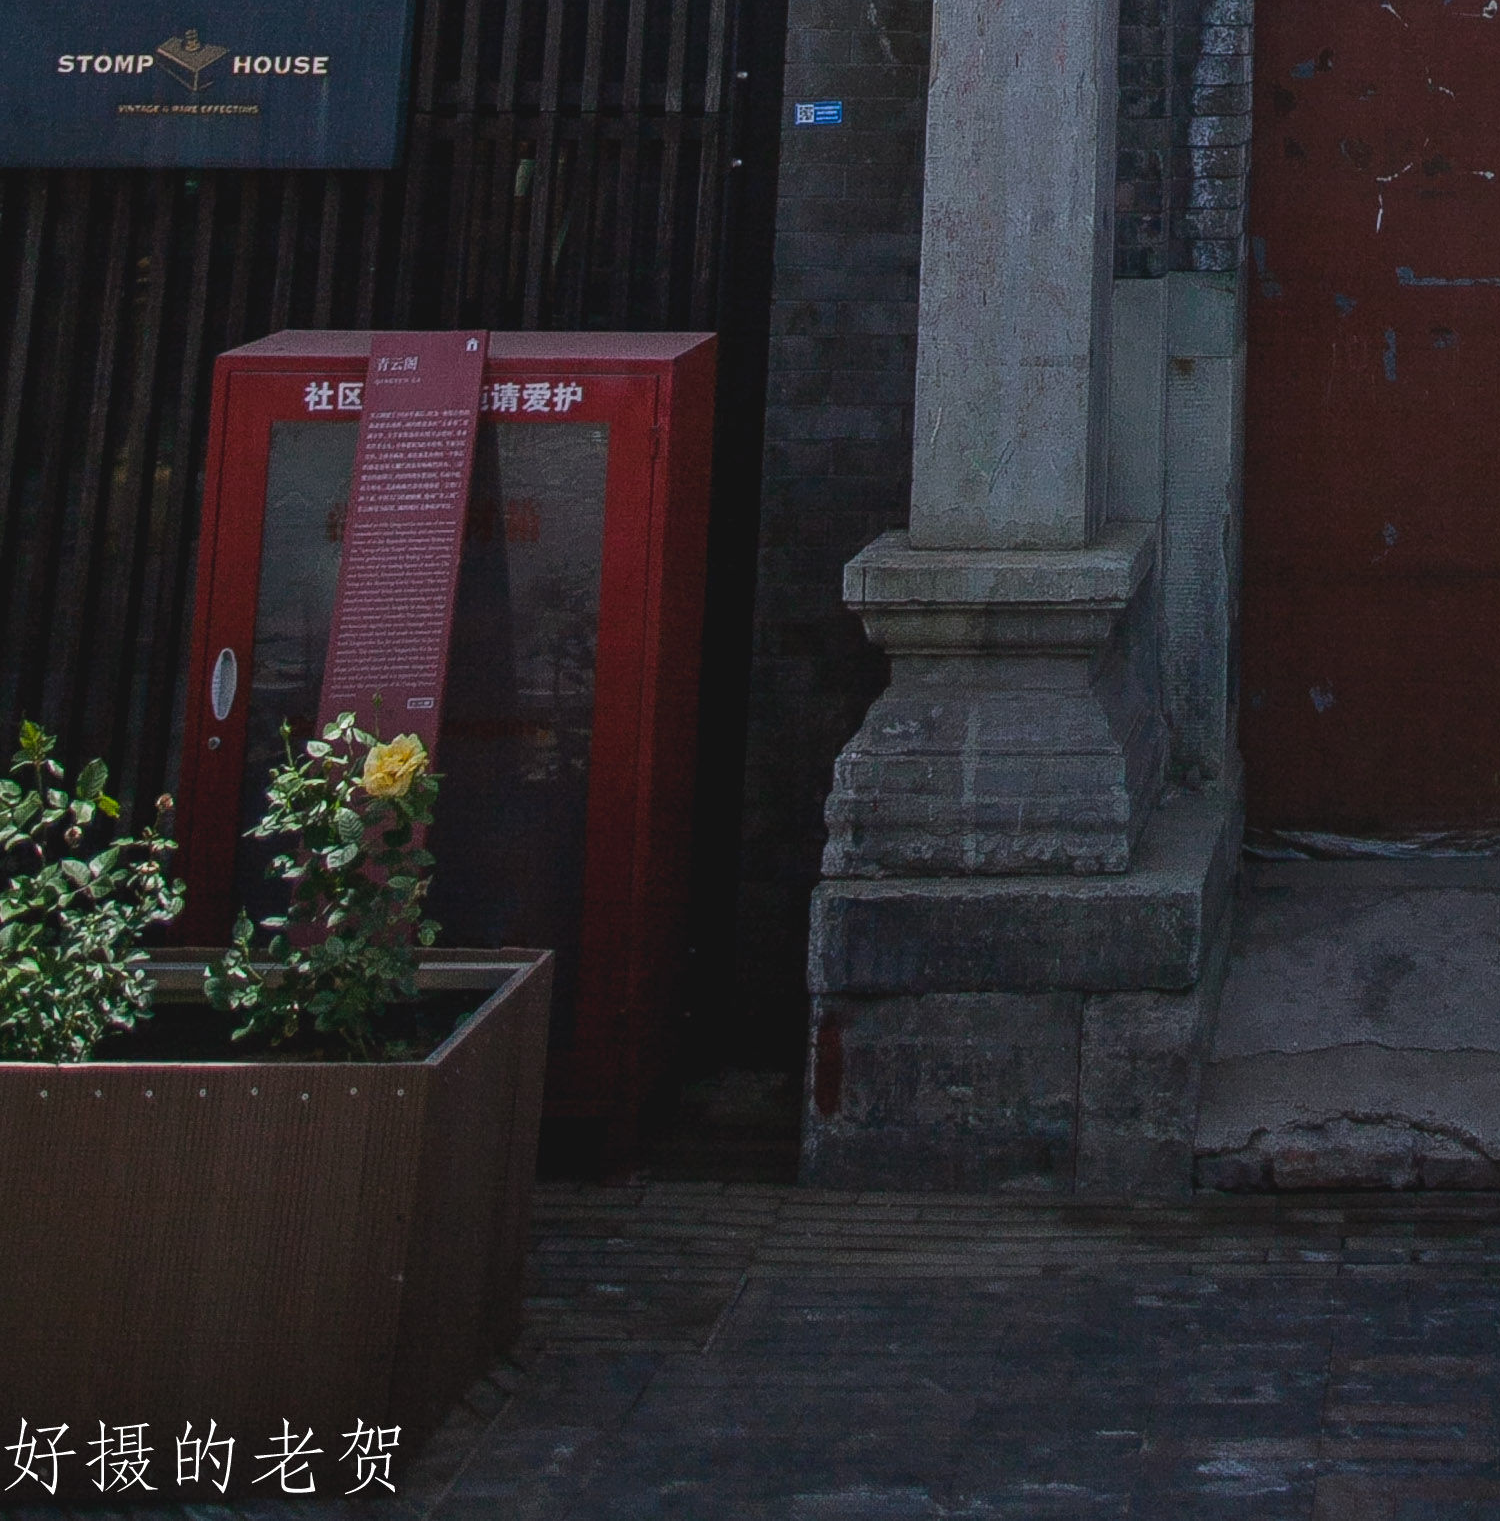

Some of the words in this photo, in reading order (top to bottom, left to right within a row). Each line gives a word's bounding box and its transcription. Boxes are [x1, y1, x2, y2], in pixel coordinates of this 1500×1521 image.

[57, 55, 154, 74] STOMP
[233, 55, 329, 74] HOUSE
[375, 355, 419, 372] 青云阁
